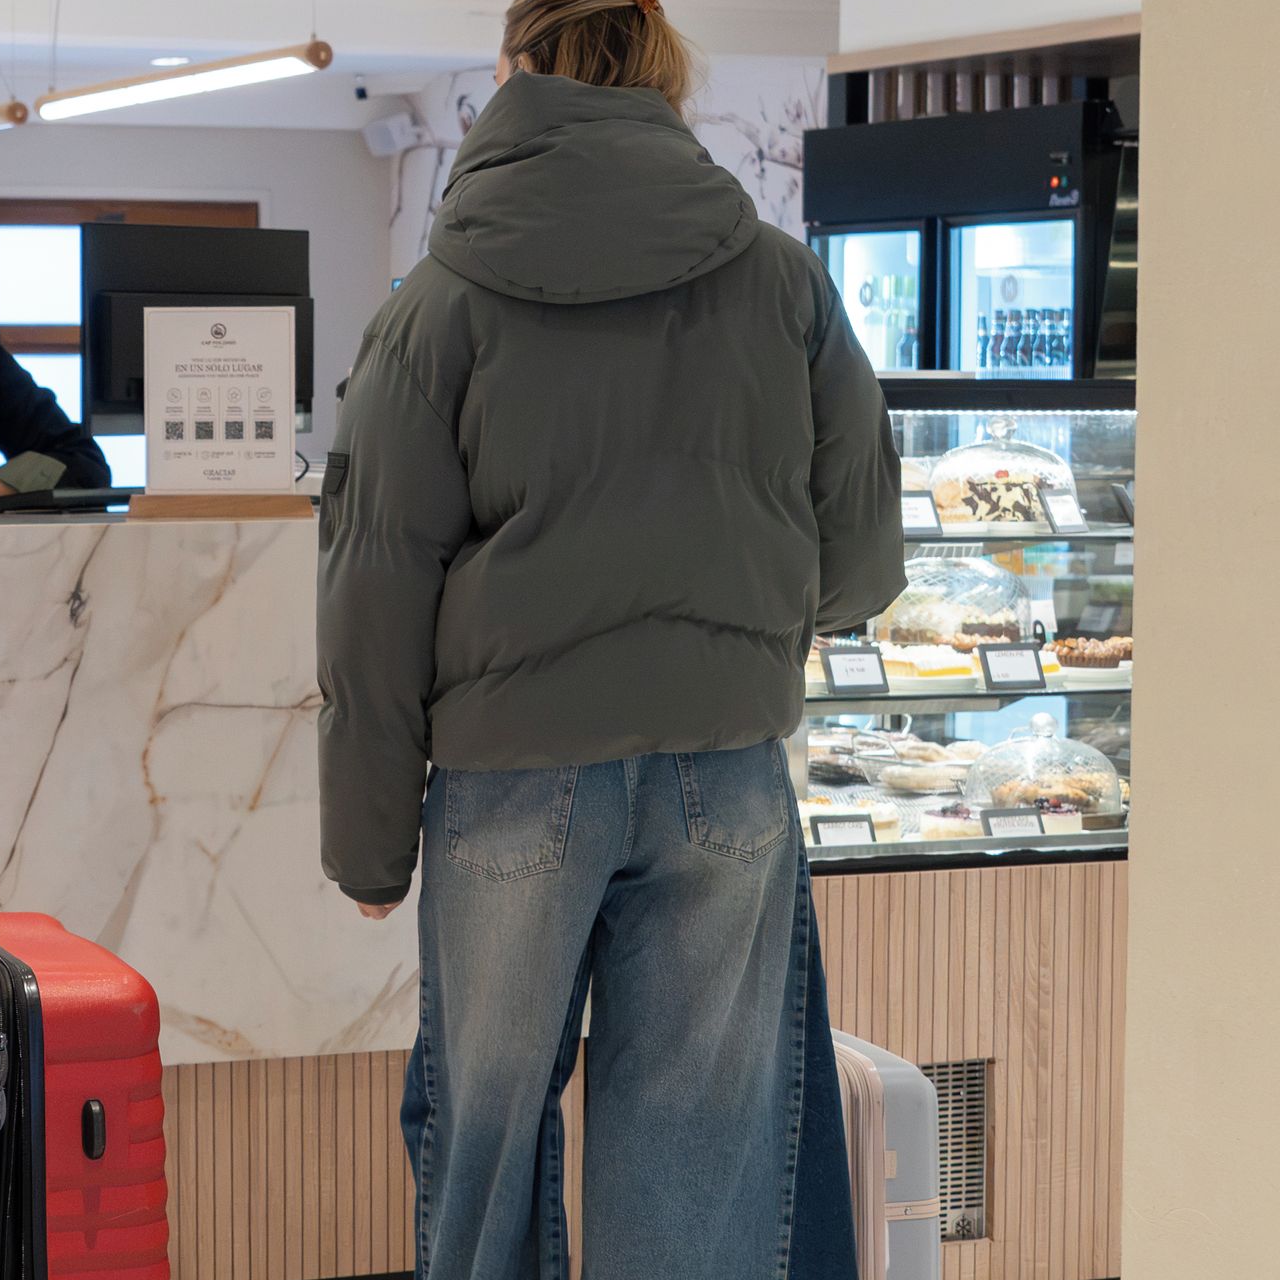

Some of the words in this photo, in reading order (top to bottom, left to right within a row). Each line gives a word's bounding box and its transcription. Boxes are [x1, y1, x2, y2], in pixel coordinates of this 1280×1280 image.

[175, 364, 187, 372] EN
[190, 364, 203, 372] UN
[205, 364, 230, 372] SOLO
[232, 364, 263, 372] LUGAR
